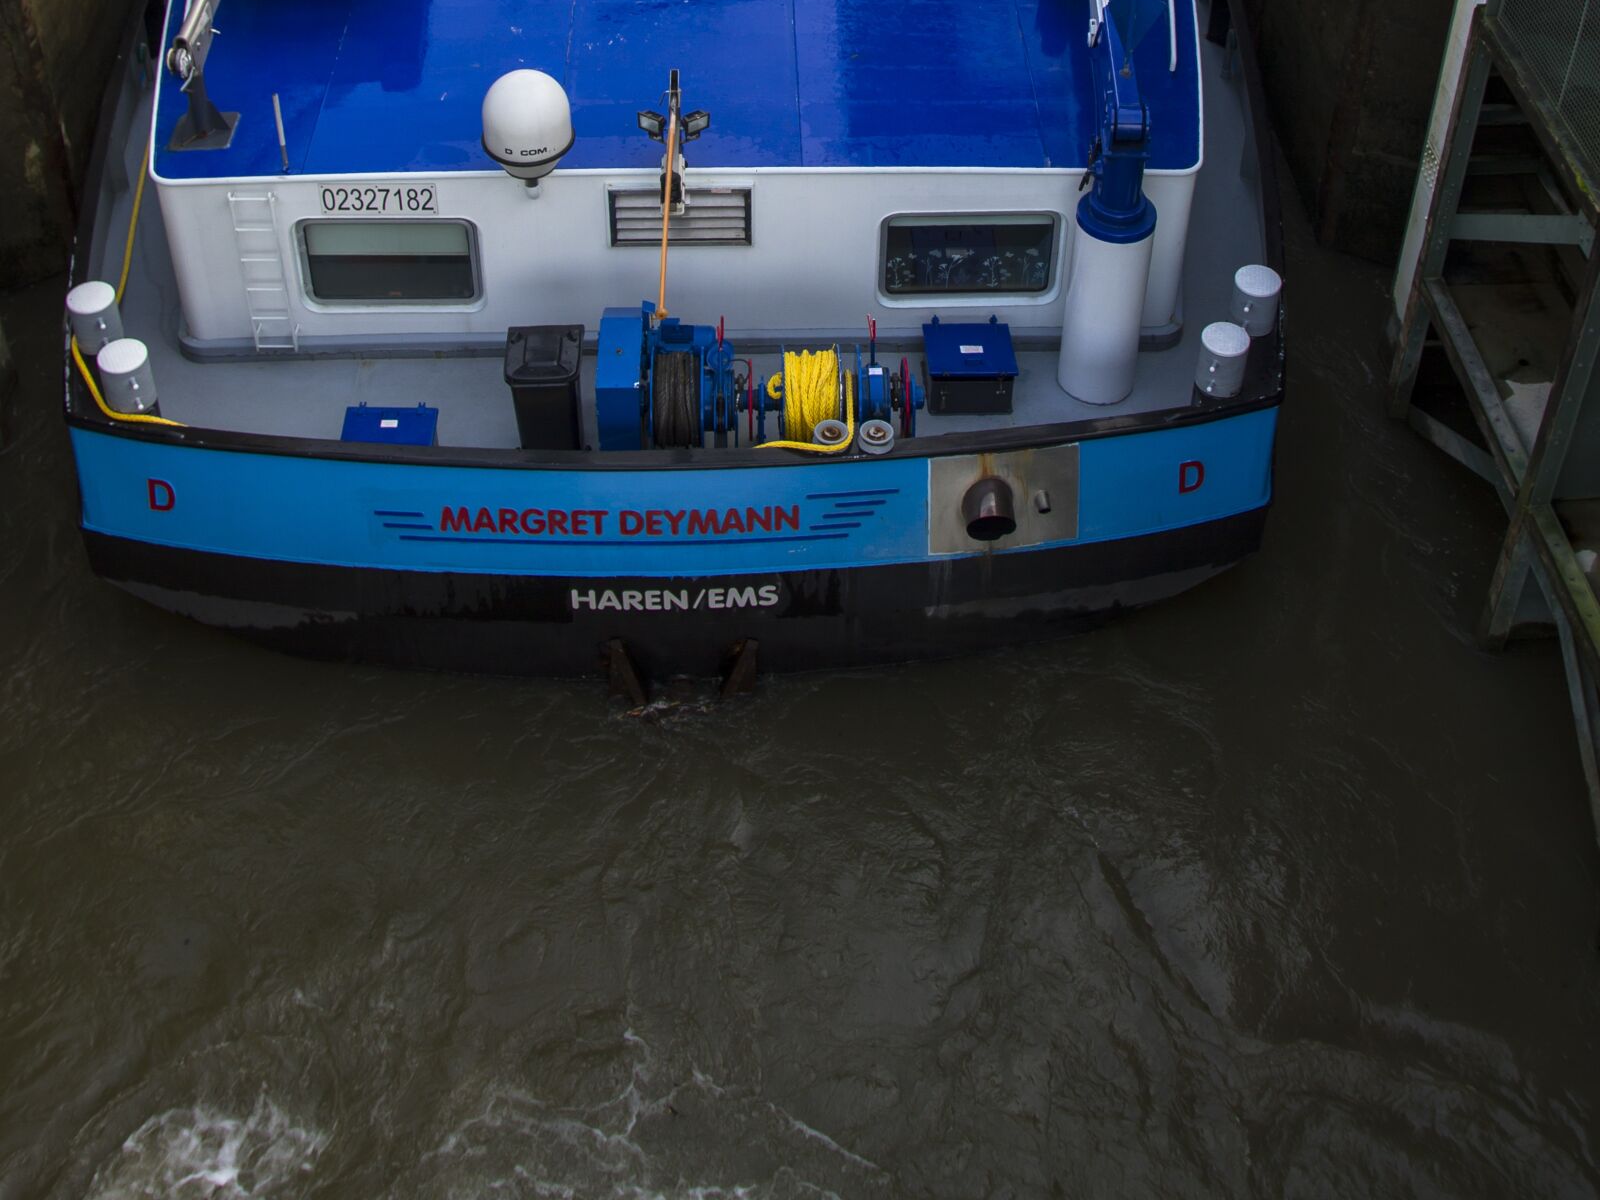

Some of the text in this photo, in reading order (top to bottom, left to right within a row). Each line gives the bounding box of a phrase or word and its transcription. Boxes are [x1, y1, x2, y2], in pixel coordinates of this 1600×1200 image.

[520, 146, 548, 156] COM
[322, 188, 434, 211] 02327182
[1178, 460, 1205, 495] D
[147, 478, 176, 511] D
[439, 504, 800, 535] MARGRET DEYMANN
[571, 585, 779, 611] HAREN/EMS
